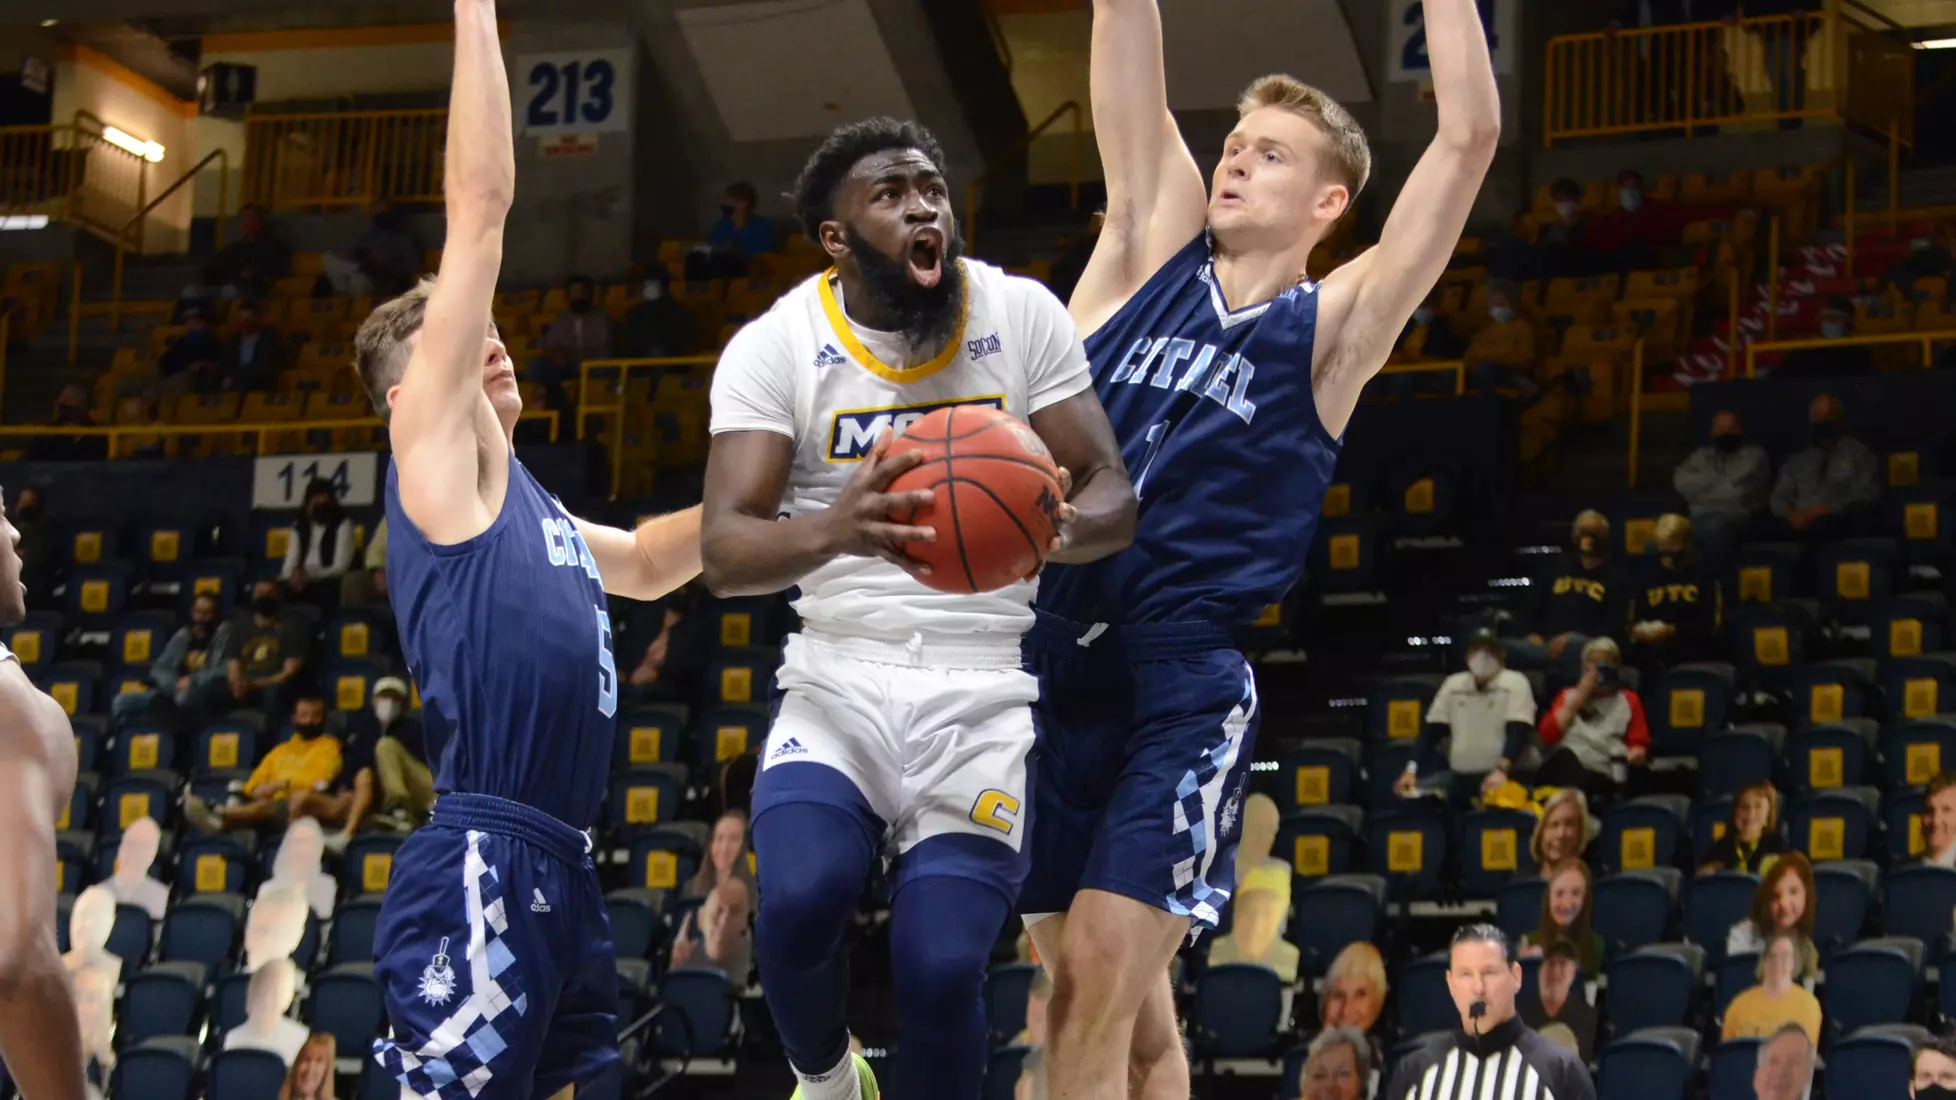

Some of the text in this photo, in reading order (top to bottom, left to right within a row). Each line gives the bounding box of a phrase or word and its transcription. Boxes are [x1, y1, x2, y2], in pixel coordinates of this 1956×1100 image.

[527, 60, 615, 126] 213
[814, 355, 846, 367] adidas
[1647, 584, 1698, 607] UTC
[595, 604, 618, 719] 5
[969, 788, 1020, 836] C
